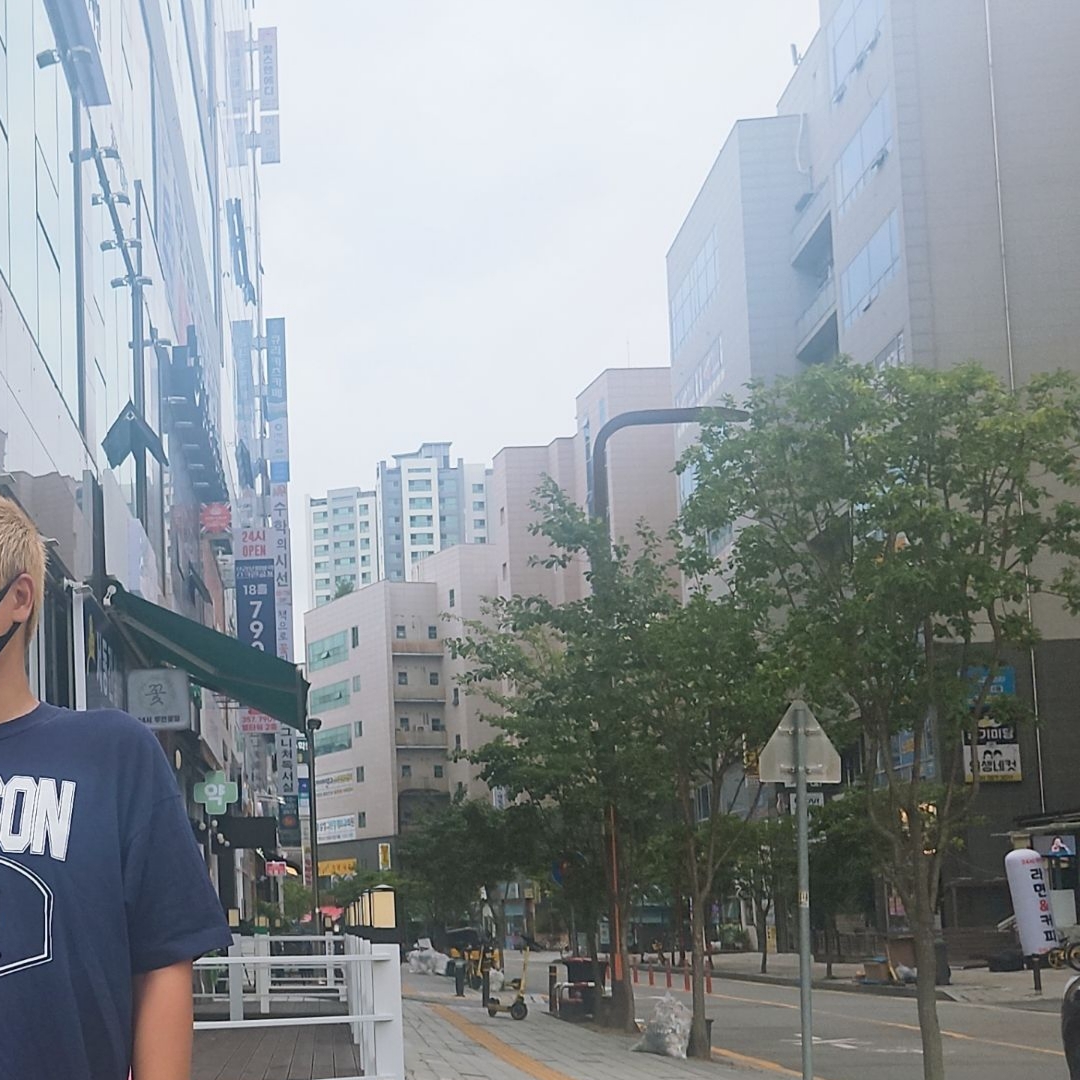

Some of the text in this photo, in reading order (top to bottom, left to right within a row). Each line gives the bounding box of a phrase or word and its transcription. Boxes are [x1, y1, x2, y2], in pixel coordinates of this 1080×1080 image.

[242, 530, 266, 543] 24시
[242, 544, 266, 557] OPEN
[144, 683, 167, 706] 꽃
[204, 783, 226, 806] 약
